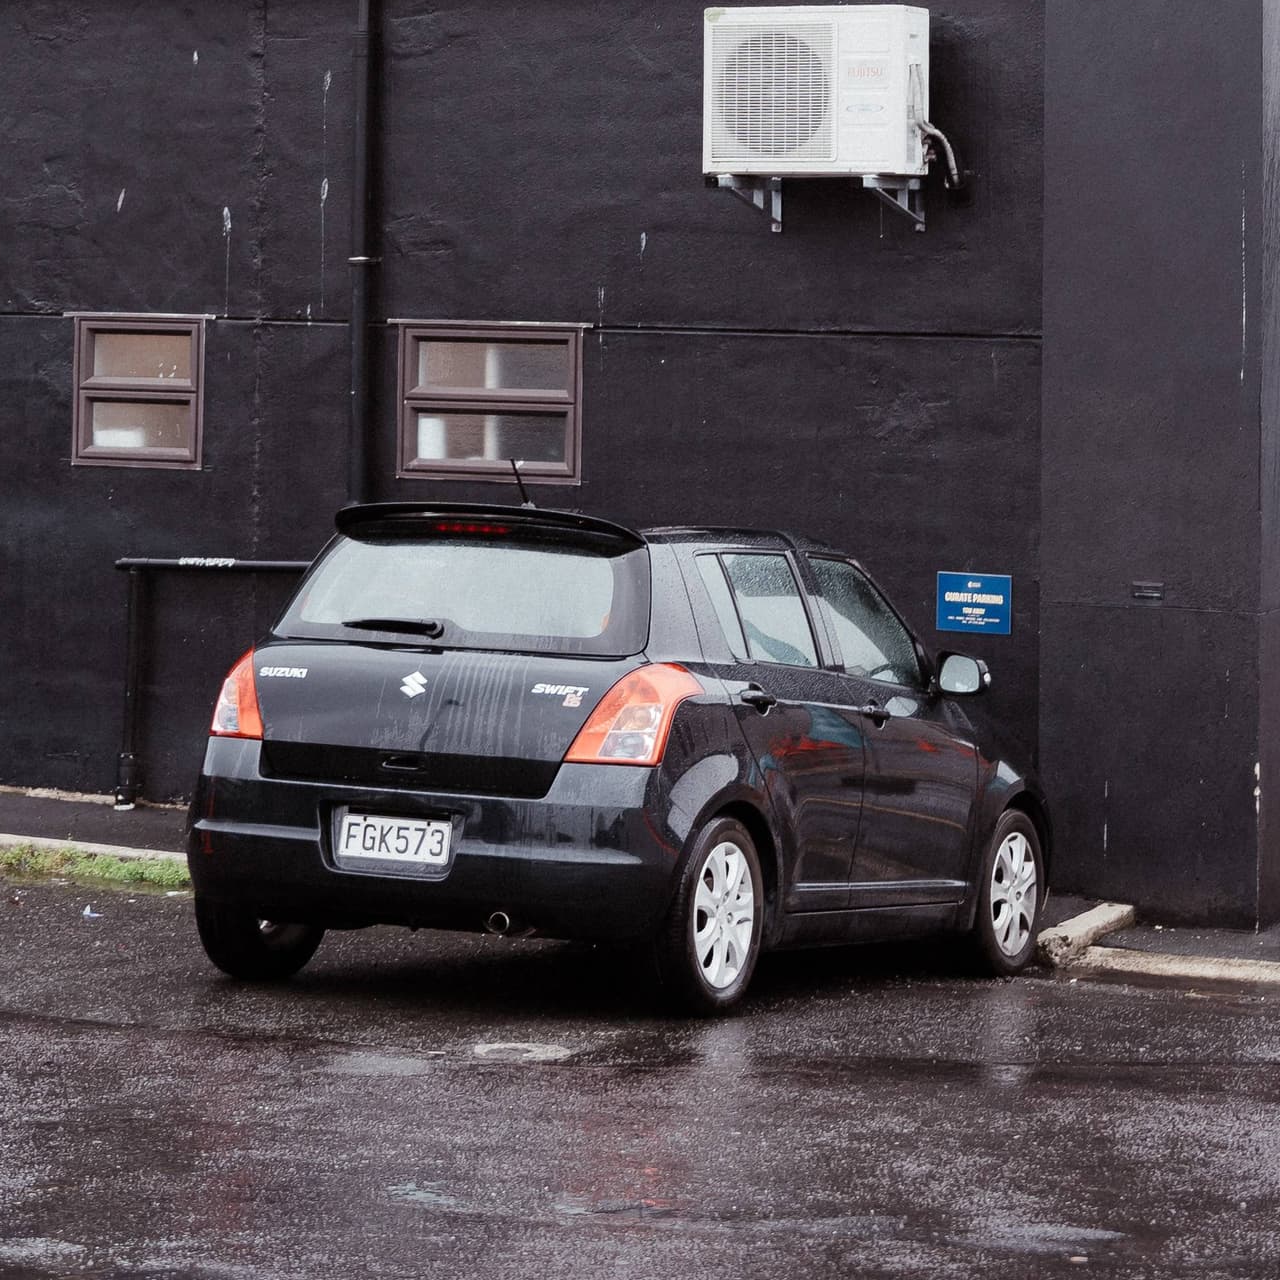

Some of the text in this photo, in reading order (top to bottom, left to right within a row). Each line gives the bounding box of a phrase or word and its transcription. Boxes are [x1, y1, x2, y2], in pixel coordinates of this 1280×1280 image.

[259, 666, 308, 679] SUZUKI
[531, 683, 590, 696] SWIFT
[345, 822, 445, 857] FGK573
